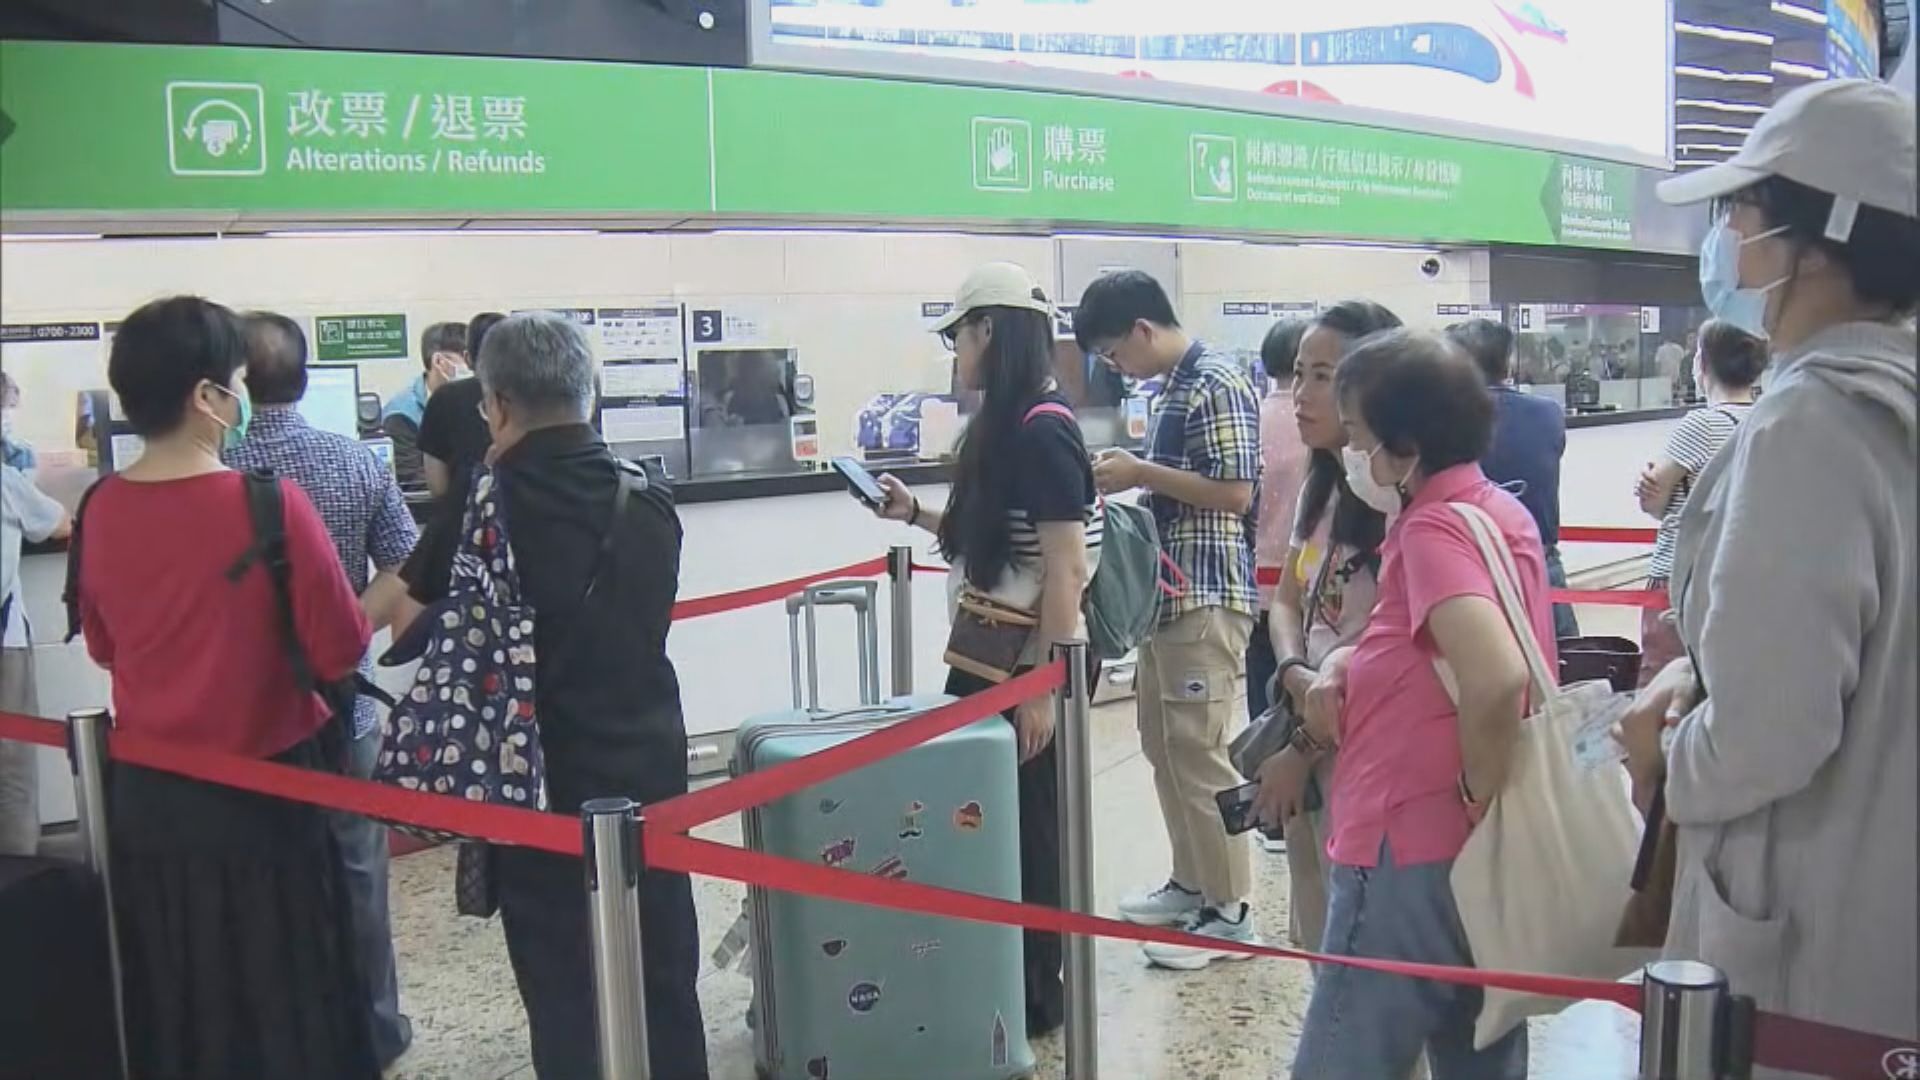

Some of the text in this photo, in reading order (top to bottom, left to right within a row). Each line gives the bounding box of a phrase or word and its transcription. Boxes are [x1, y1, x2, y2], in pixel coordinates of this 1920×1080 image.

[287, 90, 527, 141] 改票 / 退票
[1043, 125, 1107, 165] 購票
[286, 147, 545, 174] Alterations / Refunds
[1043, 170, 1115, 192] Purchase
[701, 315, 713, 337] 3
